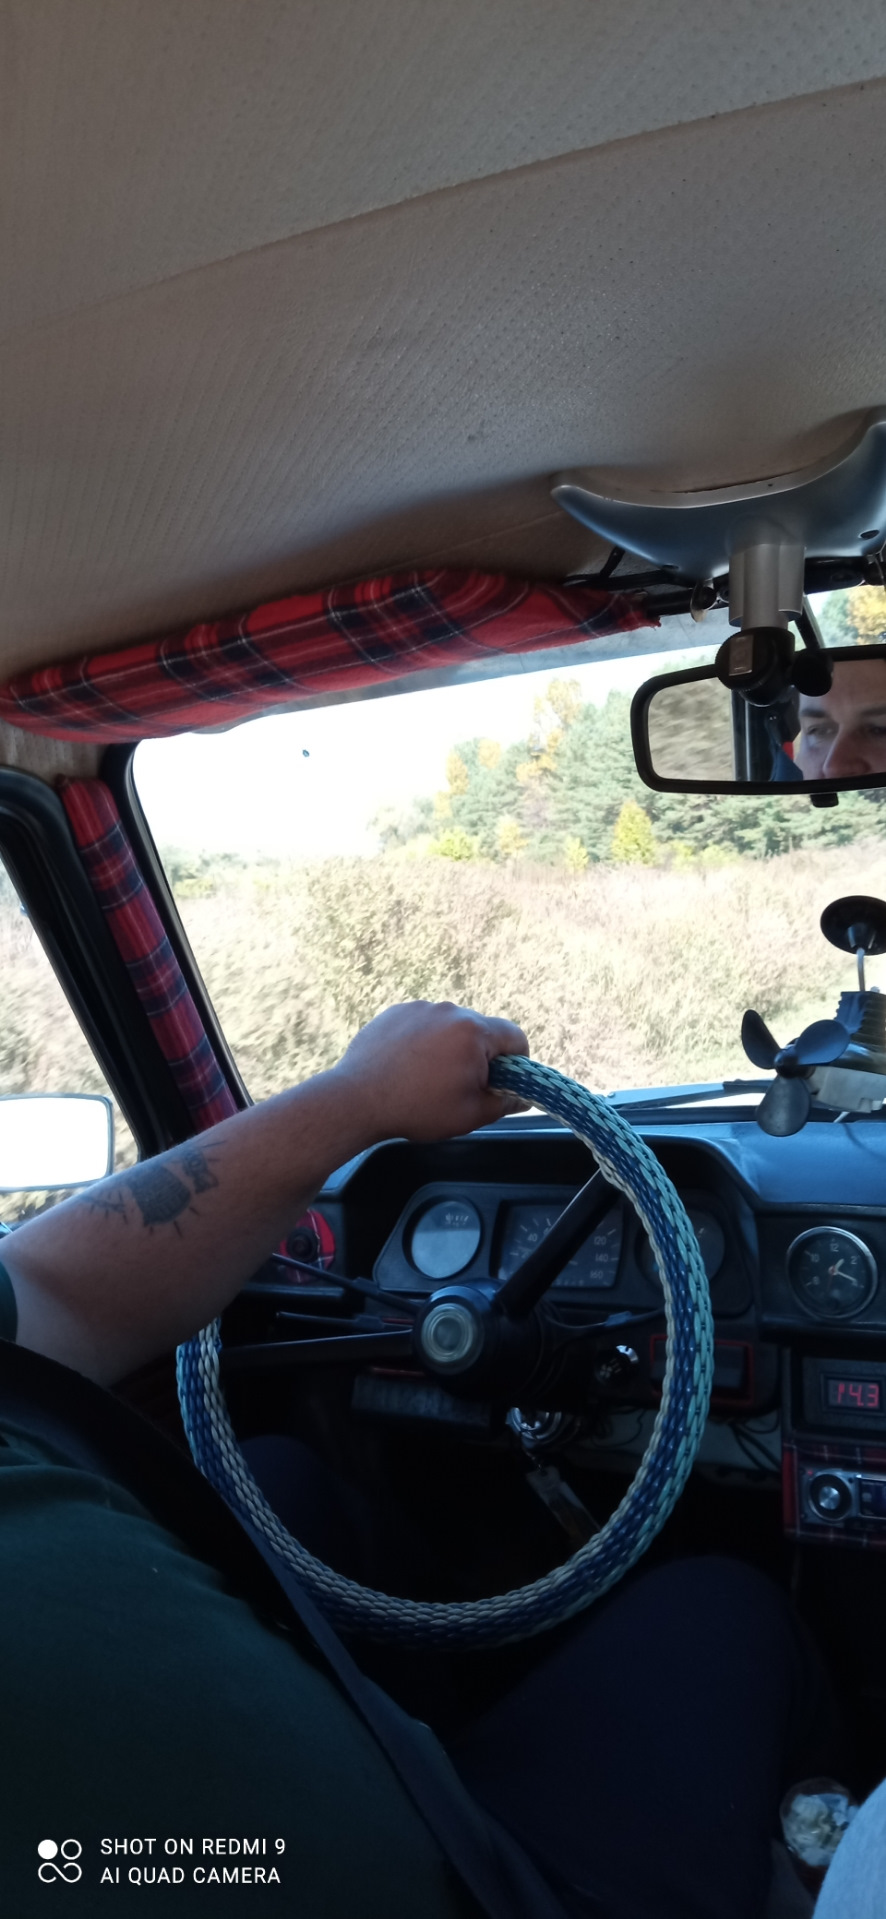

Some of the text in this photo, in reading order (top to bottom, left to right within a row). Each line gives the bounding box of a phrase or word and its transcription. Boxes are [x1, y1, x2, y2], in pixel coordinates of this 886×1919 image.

[527, 1233, 538, 1242] 40
[594, 1236, 607, 1245] 120
[829, 1243, 839, 1252] 12
[595, 1253, 609, 1262] 140
[850, 1256, 858, 1265] 2
[590, 1270, 604, 1280] 160
